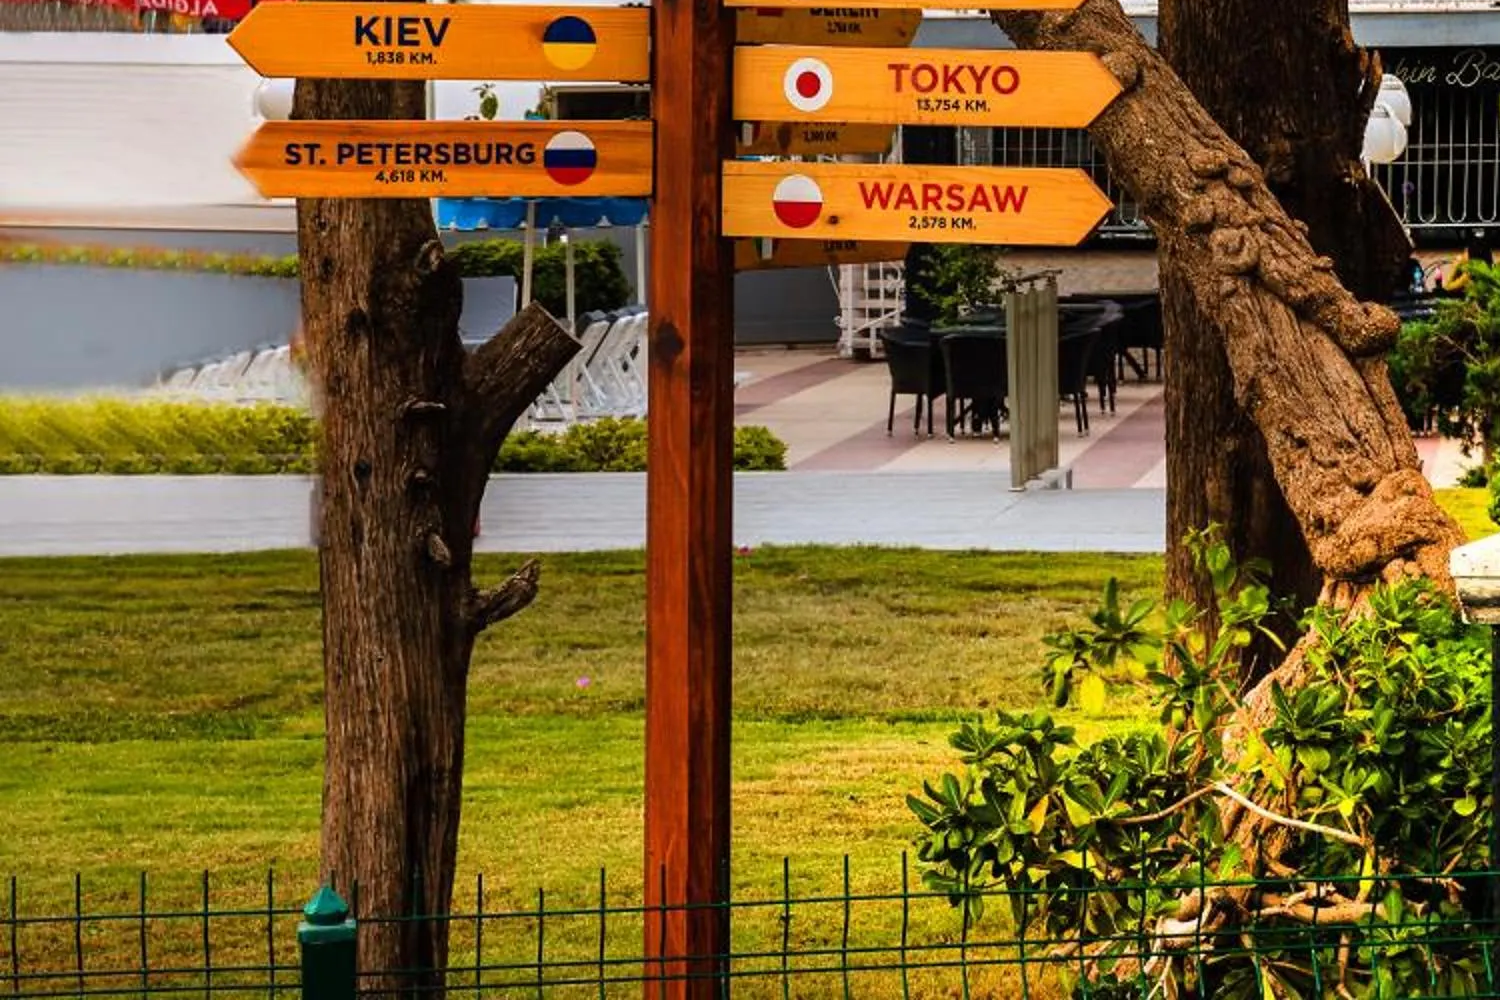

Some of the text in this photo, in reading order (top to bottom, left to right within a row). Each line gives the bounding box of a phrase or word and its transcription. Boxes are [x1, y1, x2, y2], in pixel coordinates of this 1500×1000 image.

[355, 16, 451, 47] KIEV
[366, 52, 437, 65] 1,838 KM.
[888, 64, 1020, 94] TOKYO
[917, 99, 991, 113] 13,754 KM.
[285, 143, 535, 165] ST. PETERSBURG
[375, 170, 447, 183] 4,618 KM.
[859, 181, 1028, 213] WARSAW
[909, 216, 977, 230] 2,578 KM.
